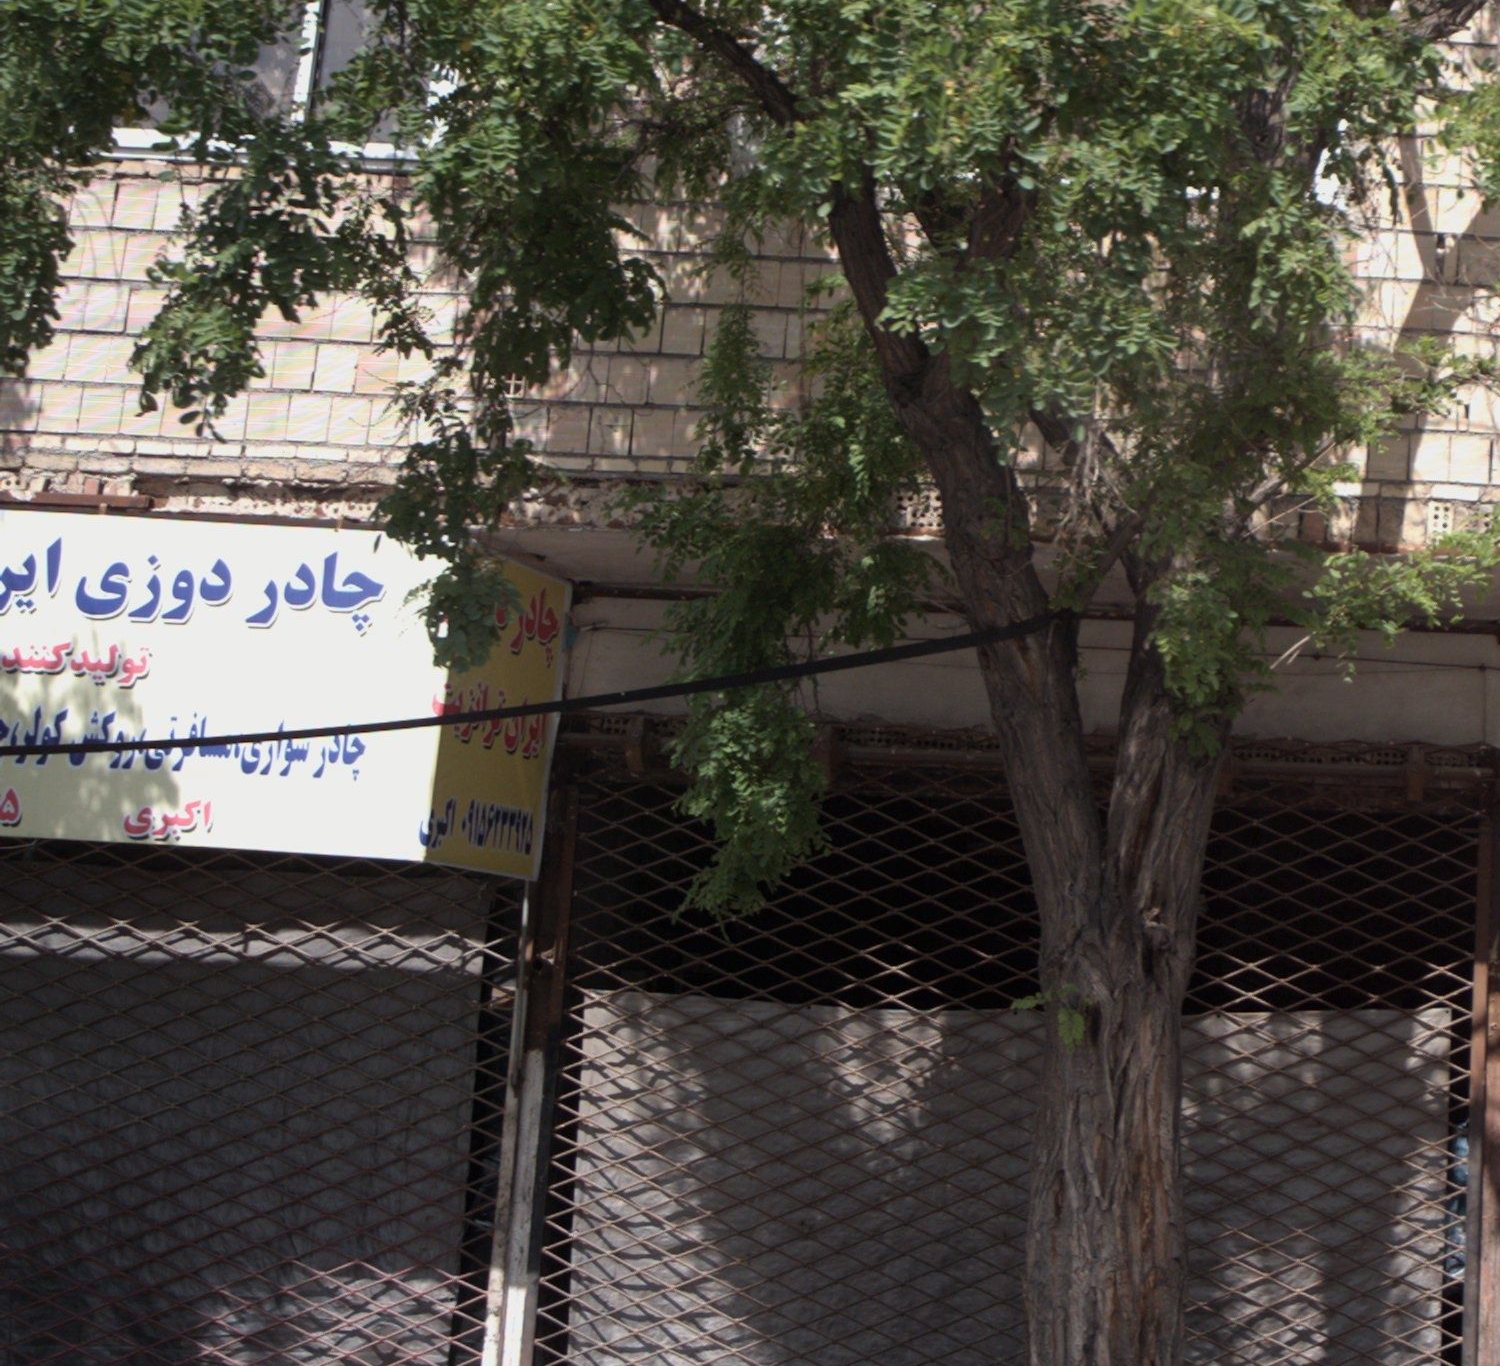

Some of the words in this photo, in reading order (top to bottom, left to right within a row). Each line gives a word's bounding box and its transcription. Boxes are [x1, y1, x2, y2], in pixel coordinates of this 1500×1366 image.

[75, 554, 233, 621] دوزی
[245, 551, 386, 633] چادر
[509, 586, 559, 669] چادر
[312, 723, 366, 782] چادر
[123, 799, 213, 838] اکبری
